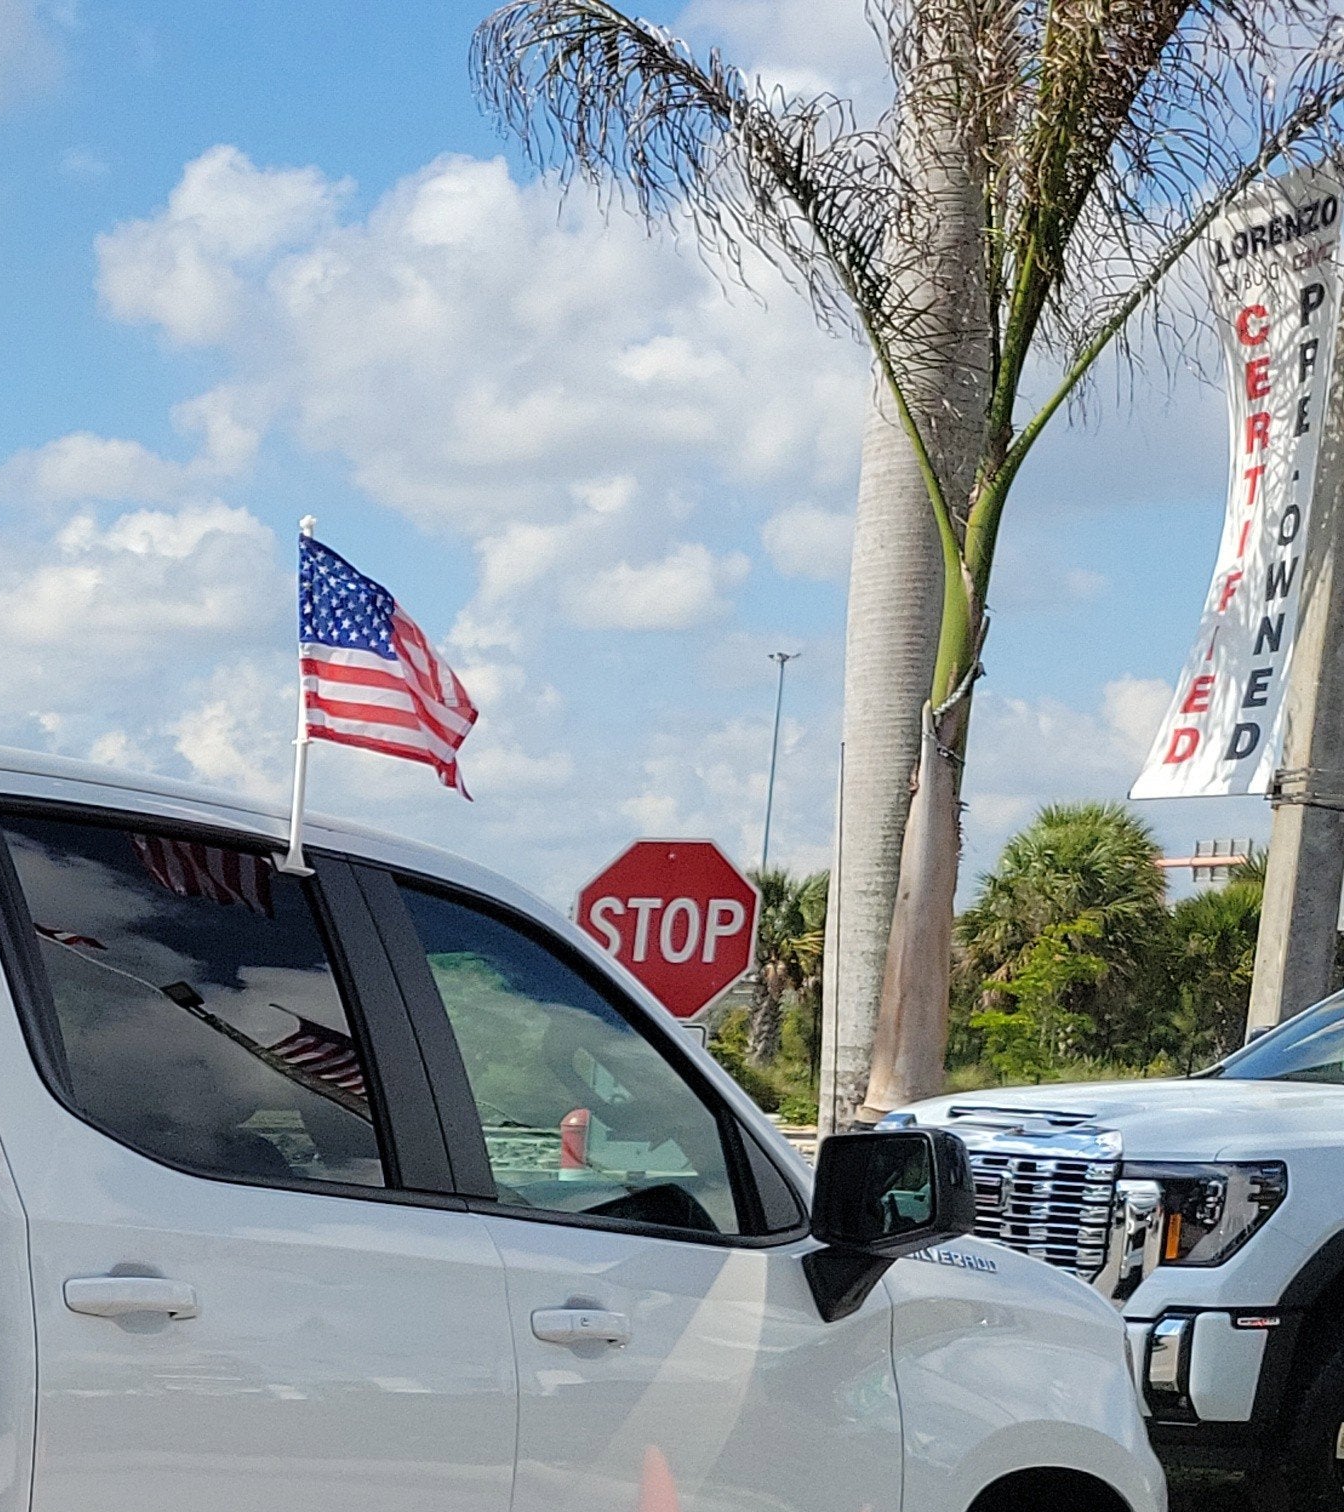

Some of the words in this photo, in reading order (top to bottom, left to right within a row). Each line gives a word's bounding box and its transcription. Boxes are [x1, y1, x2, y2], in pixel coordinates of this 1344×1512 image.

[1216, 194, 1338, 268] LORENZO
[1162, 303, 1270, 766] CERTIFIED
[589, 896, 746, 964] STOP
